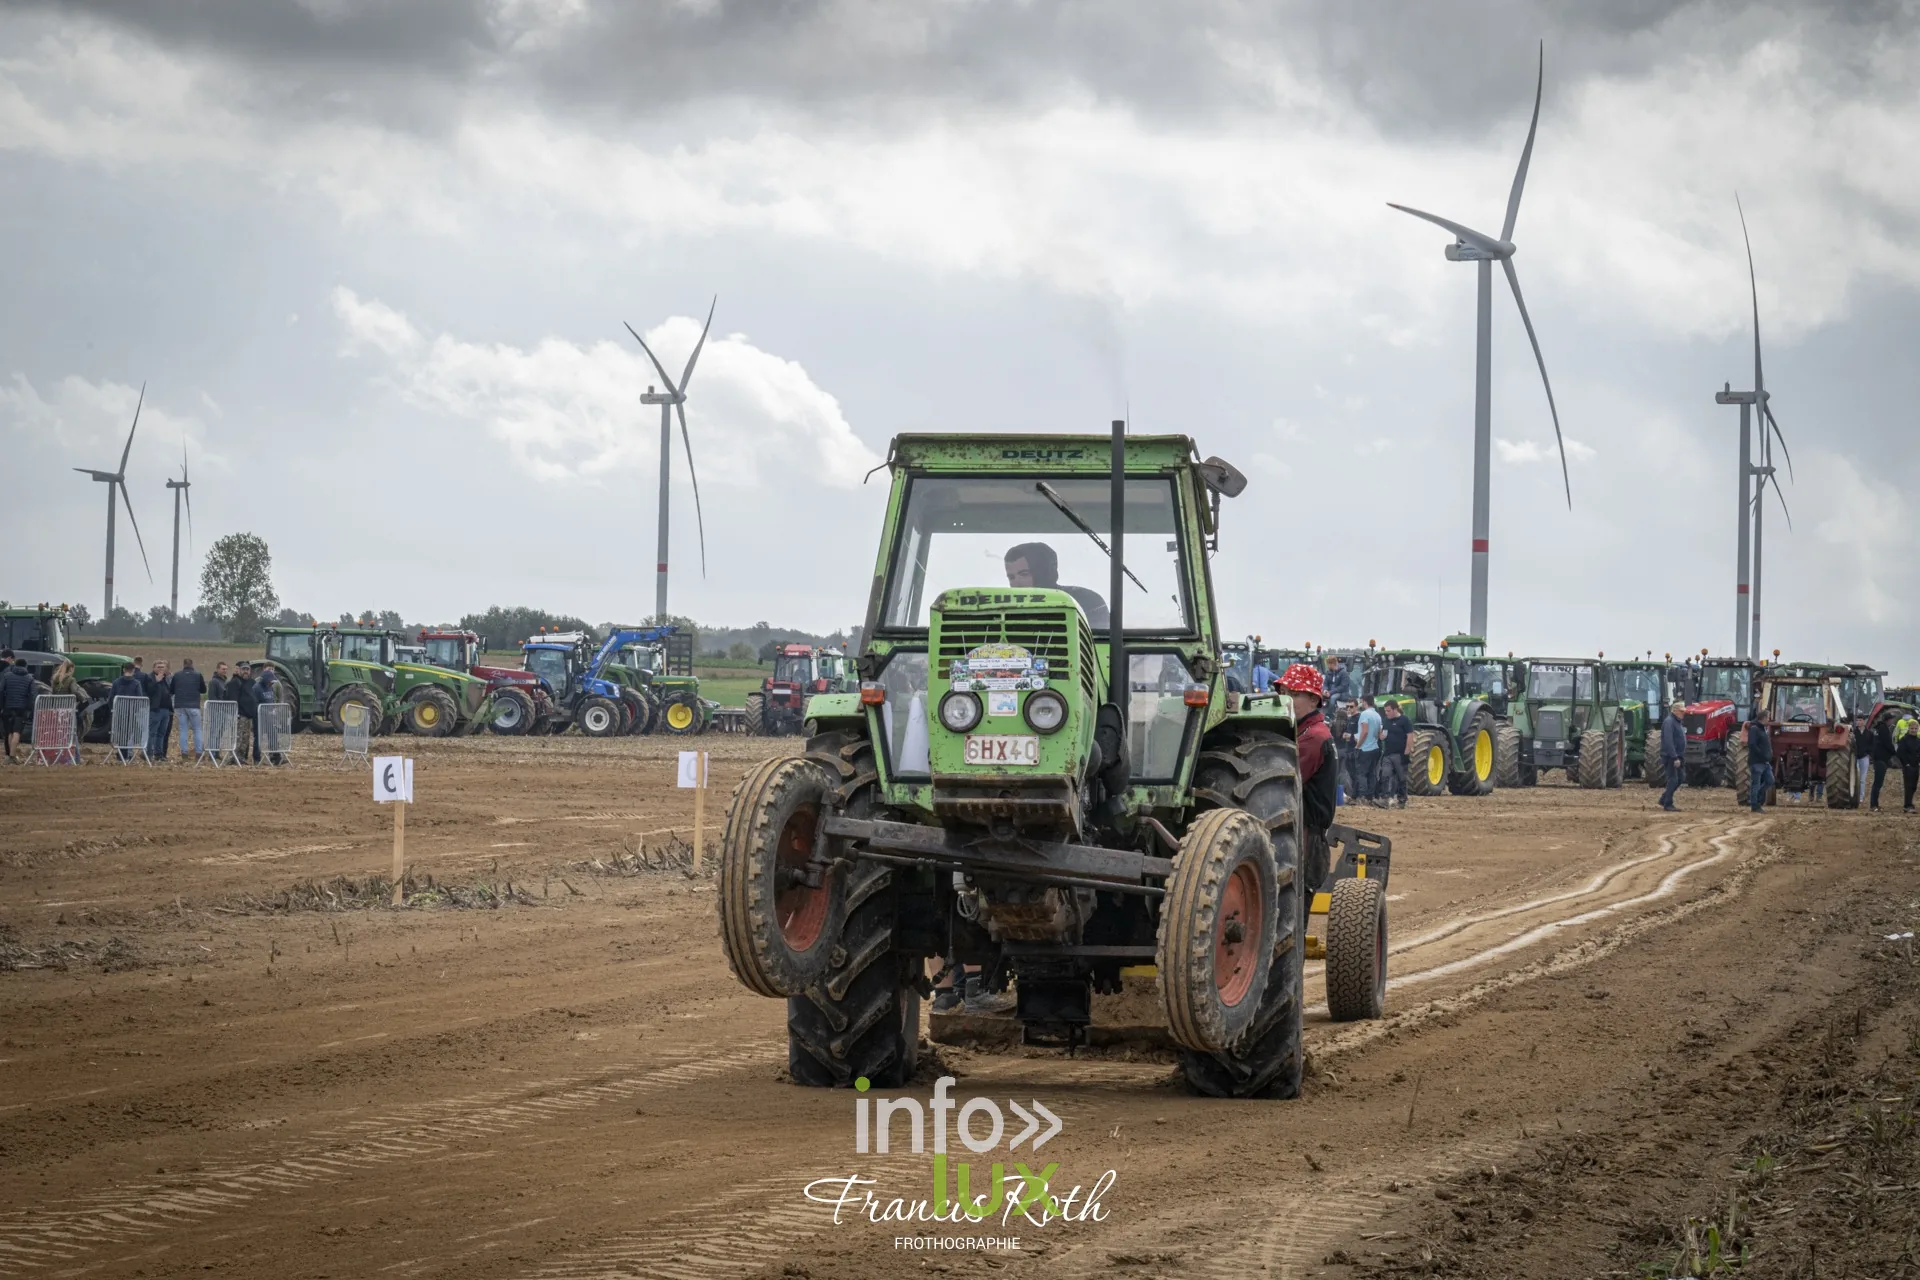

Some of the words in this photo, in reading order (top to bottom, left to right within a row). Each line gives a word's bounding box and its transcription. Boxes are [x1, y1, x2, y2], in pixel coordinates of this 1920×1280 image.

[1002, 450, 1083, 459] DEUTZ
[960, 594, 1047, 606] DEUTZ
[967, 740, 1037, 760] 6HX40
[383, 763, 397, 793] 6
